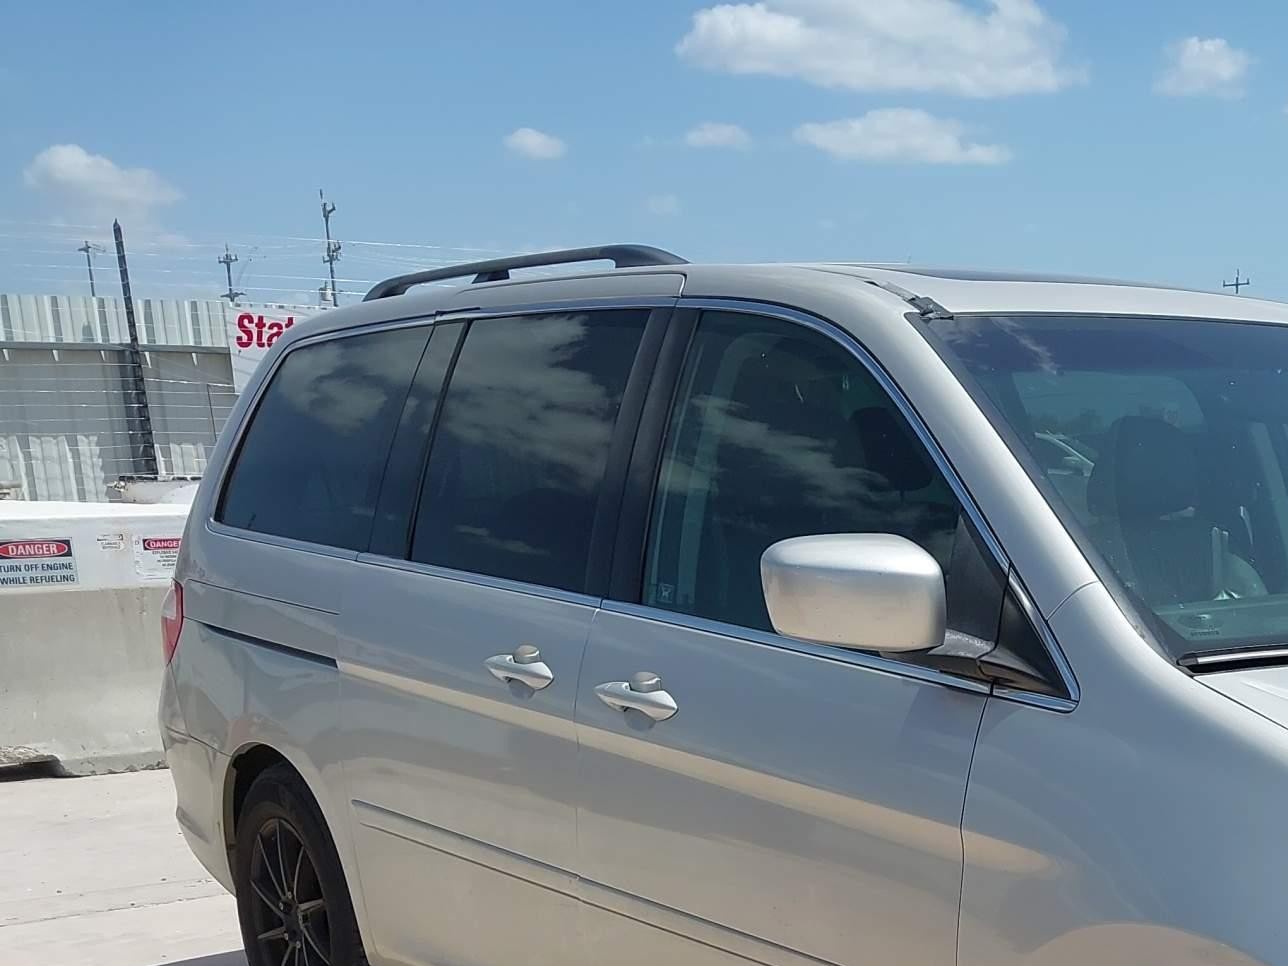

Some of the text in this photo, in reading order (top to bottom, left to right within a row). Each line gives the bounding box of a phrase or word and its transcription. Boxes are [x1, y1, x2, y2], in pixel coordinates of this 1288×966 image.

[8, 543, 58, 556] DANGER
[0, 562, 73, 573] TURN OFF ENGINE
[0, 574, 75, 585] WHILE REFUELING
